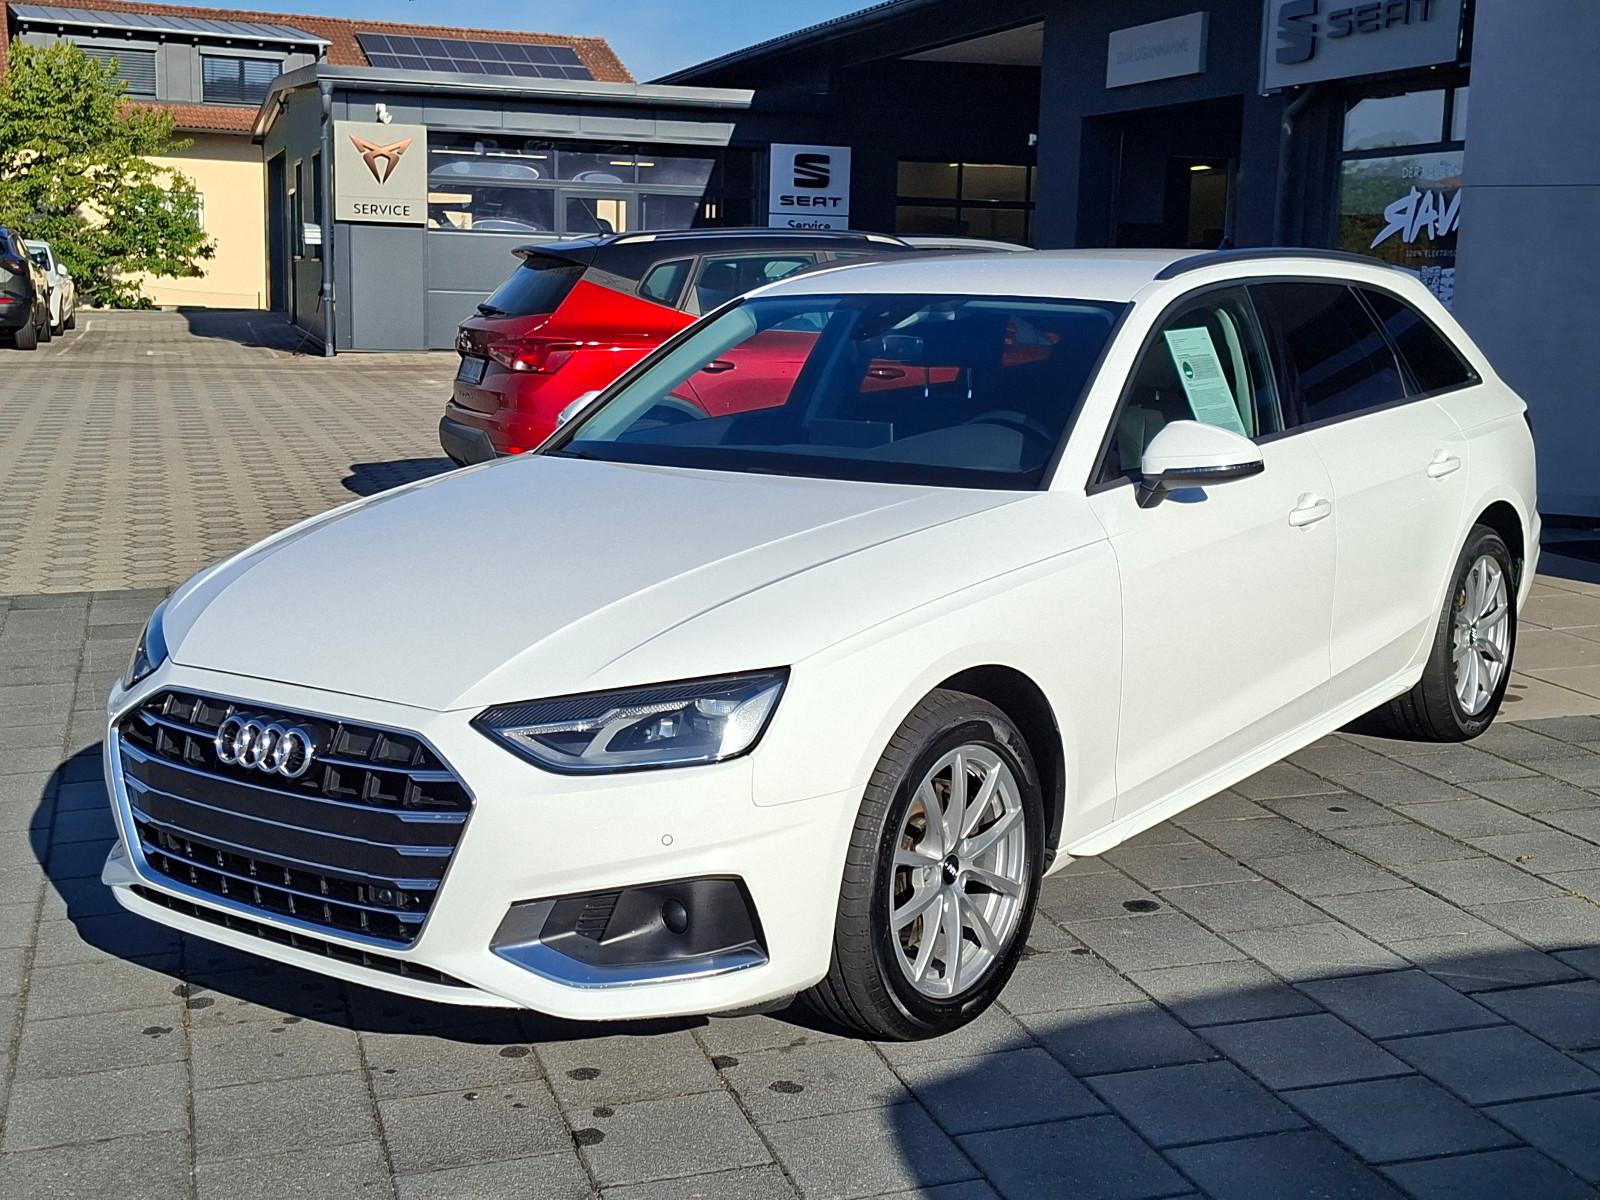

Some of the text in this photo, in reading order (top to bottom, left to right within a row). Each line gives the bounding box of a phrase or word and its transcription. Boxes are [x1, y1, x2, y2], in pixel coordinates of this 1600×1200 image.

[1325, 0, 1435, 39] SEAT
[780, 195, 842, 207] SEAT
[353, 203, 411, 217] SERVICE
